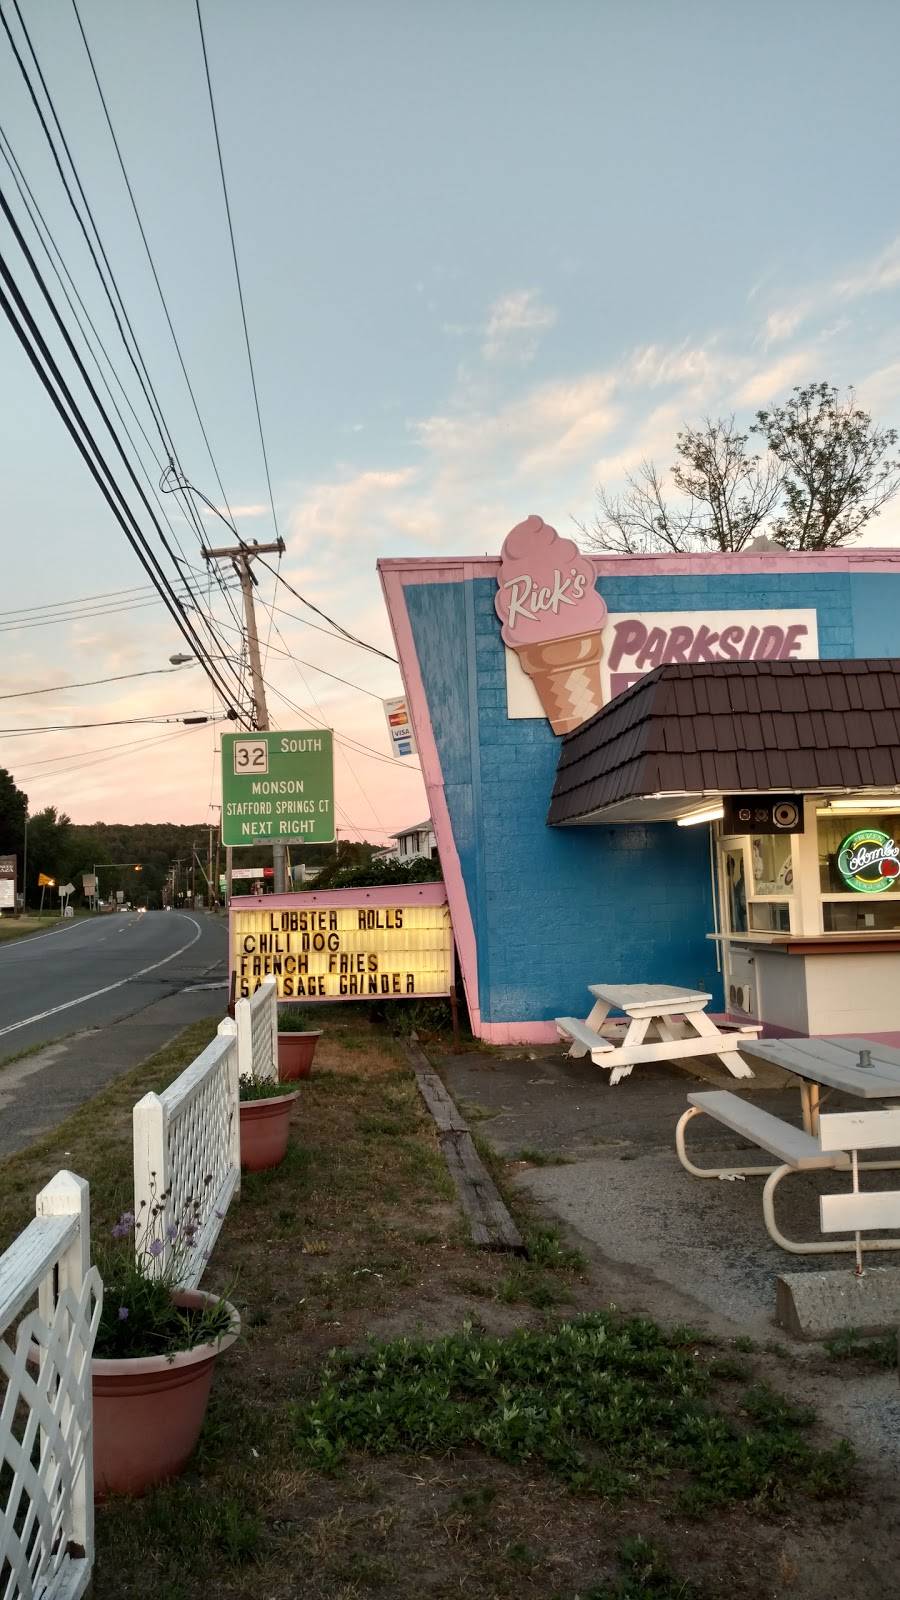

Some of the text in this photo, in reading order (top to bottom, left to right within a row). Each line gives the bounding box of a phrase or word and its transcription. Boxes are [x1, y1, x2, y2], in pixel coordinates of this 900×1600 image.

[607, 619, 808, 672] PARKSIDE
[394, 728, 410, 737] VISA
[280, 738, 322, 753] SOUTH
[238, 748, 265, 766] 32
[252, 780, 304, 795] MONSON
[226, 800, 329, 816] STAFFORD SPRINGS CT
[242, 820, 316, 835] NEXT RIGHT
[838, 839, 900, 875] Colombo
[270, 909, 403, 932] LOBSTER ROLLS
[243, 932, 340, 954] CHILI DOG
[241, 953, 378, 976] FRENCH FRIES
[241, 974, 415, 998] SASAGE GRINDER
